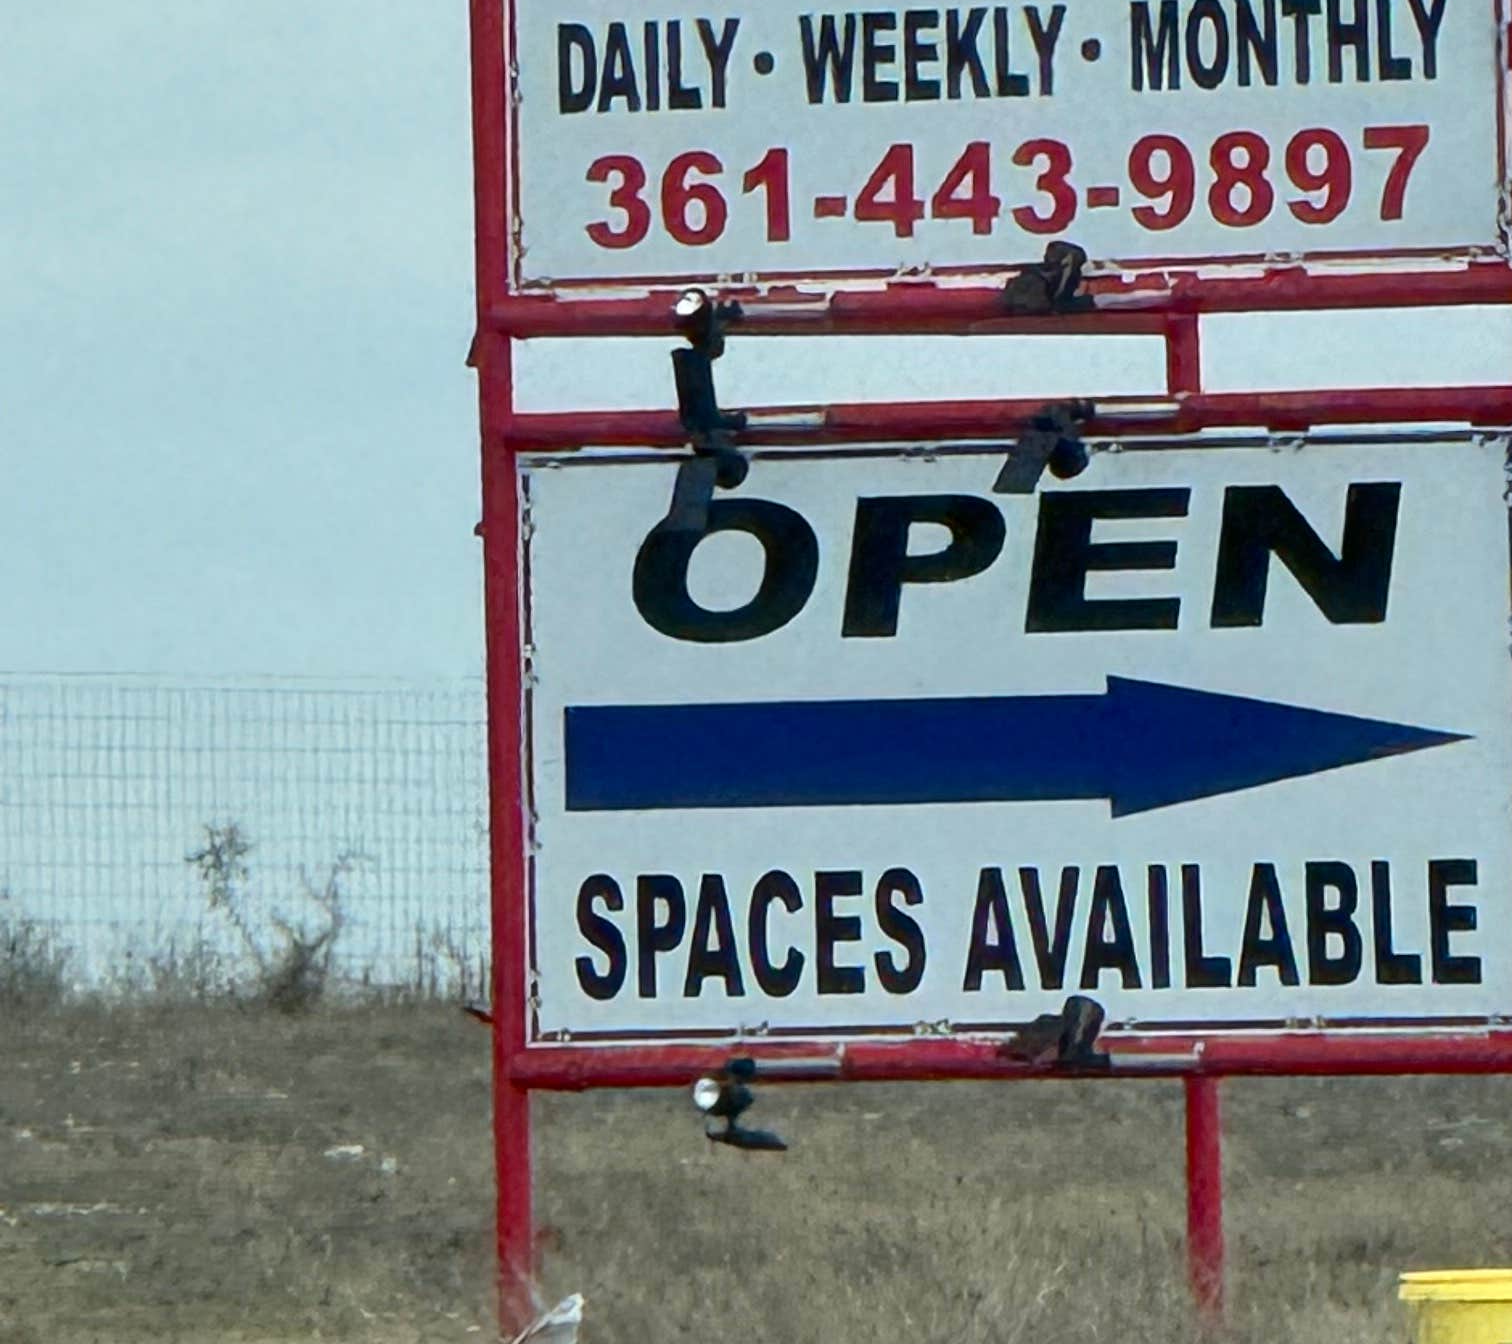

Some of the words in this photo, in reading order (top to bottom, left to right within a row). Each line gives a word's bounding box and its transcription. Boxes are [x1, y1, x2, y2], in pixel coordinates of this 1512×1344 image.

[557, 17, 740, 115] DAILY
[799, 4, 1067, 105] WEEKLY
[584, 123, 1431, 251] 361-443-9897
[632, 481, 1402, 643] OPEN
[575, 865, 926, 1001] SPACES
[964, 858, 1483, 993] AVAILABLE
